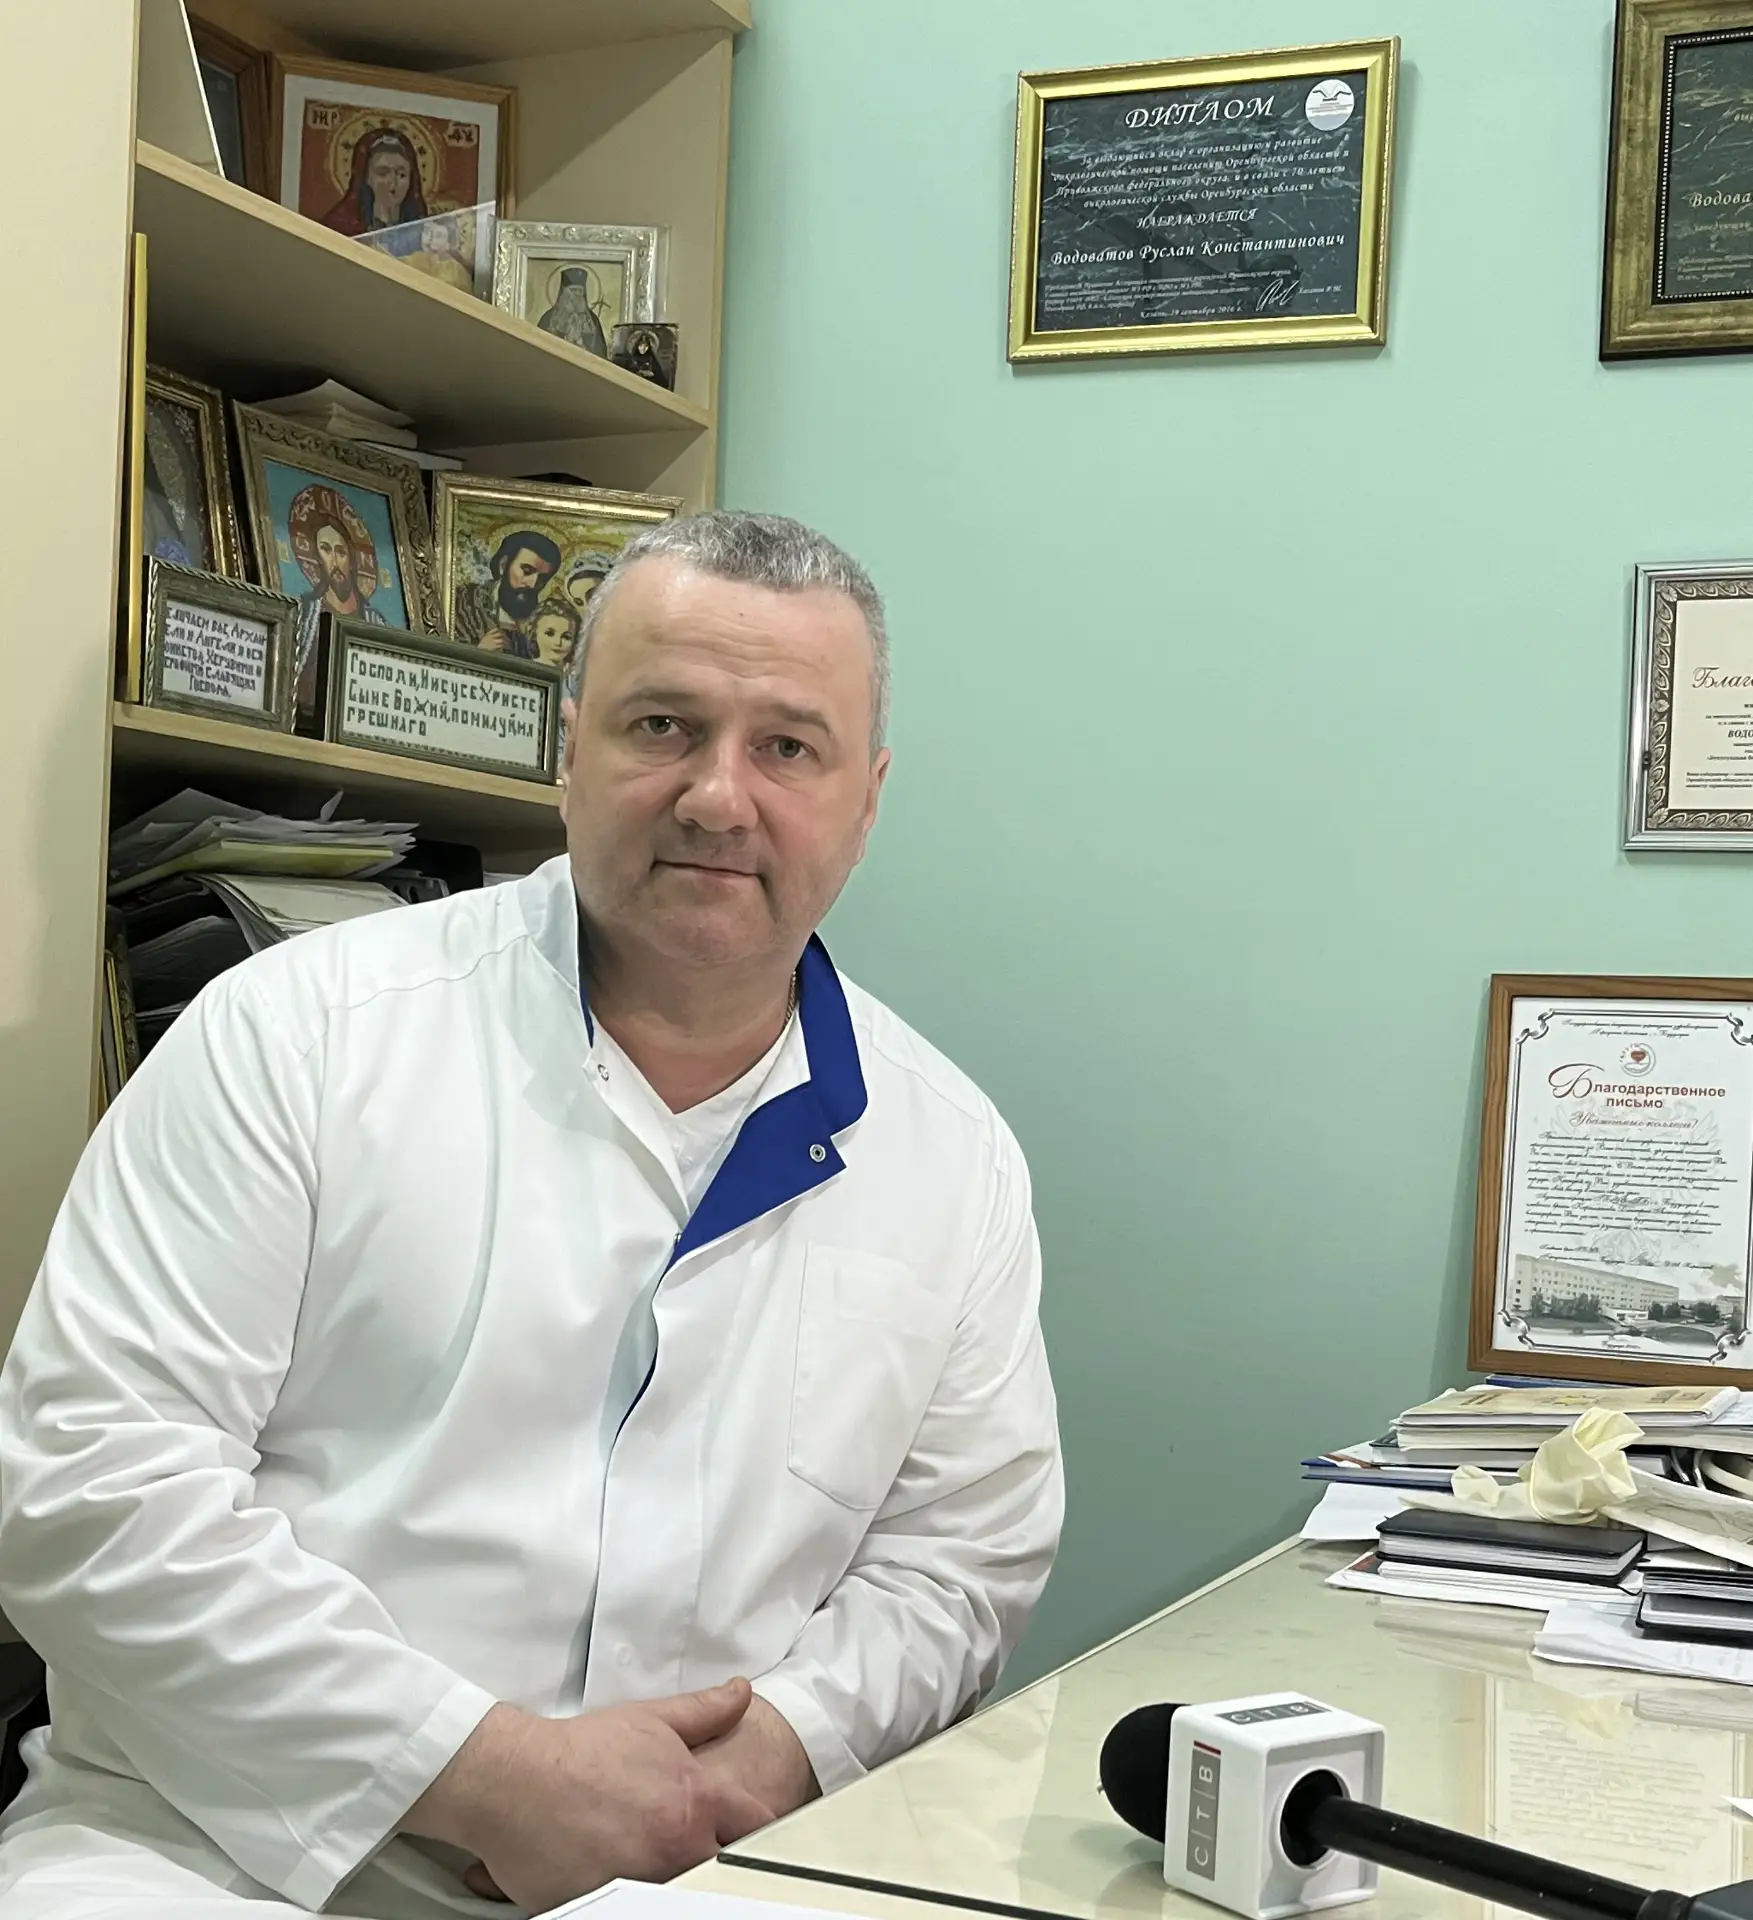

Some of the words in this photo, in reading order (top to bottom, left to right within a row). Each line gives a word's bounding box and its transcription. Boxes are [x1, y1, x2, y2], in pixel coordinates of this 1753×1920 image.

[1125, 95, 1275, 129] ДИПЛОМ
[1197, 141, 1262, 155] организацию
[1274, 137, 1322, 150] развитие
[1131, 165, 1168, 176] помощи
[1172, 160, 1222, 172] населению
[1226, 153, 1294, 168] Оренбургской
[1298, 149, 1341, 161] области
[1056, 184, 1124, 198] Приволжского
[1127, 177, 1191, 192] федерального
[1161, 190, 1198, 204] службы
[1201, 185, 1269, 200] Оренбургской
[1272, 182, 1315, 193] области
[1691, 191, 1752, 207] Водова
[1136, 207, 1258, 228] НАГРАЖДАЕТСЯ
[1051, 246, 1134, 265] Водоватов
[1139, 245, 1195, 262] Руслан
[1201, 233, 1346, 257] Константинович
[1692, 666, 1753, 689] Благ
[348, 678, 390, 708] Сыне
[479, 681, 536, 713] Христе
[1548, 1063, 1726, 1099] Благодарственное
[1606, 1097, 1664, 1109] письмо
